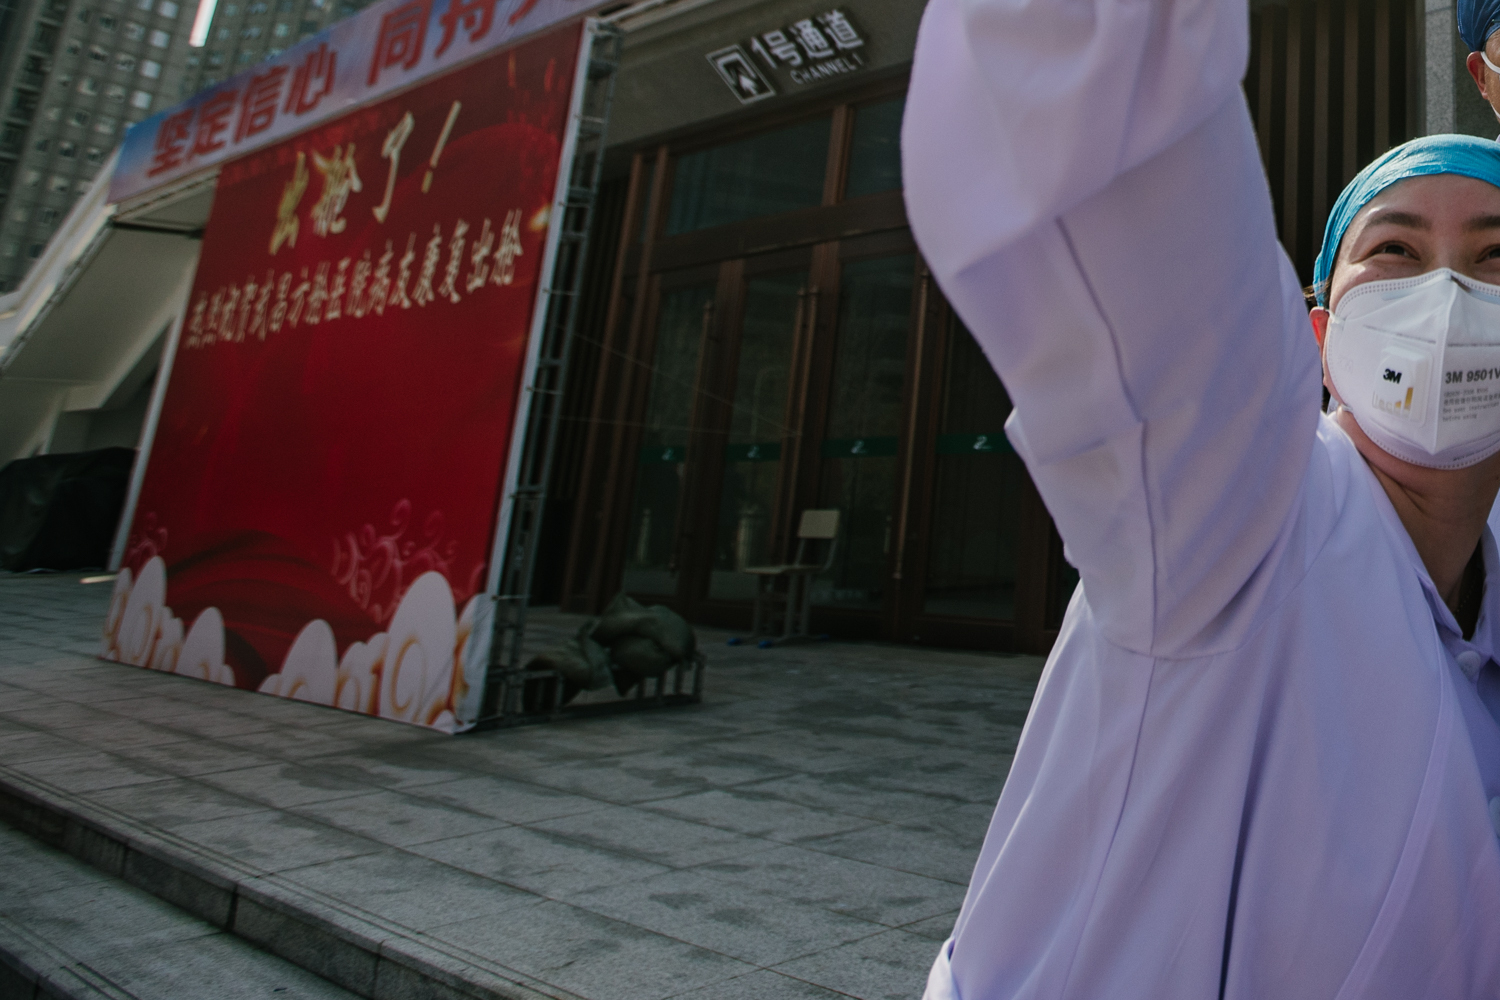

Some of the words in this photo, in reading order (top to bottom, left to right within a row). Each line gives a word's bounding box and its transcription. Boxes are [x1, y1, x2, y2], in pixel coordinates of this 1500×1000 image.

[751, 9, 864, 69] 1号通道
[789, 56, 857, 84] CHANNEL
[147, 42, 336, 178] 坚定信心
[1383, 368, 1402, 384] 3M
[1445, 371, 1463, 384] 3M
